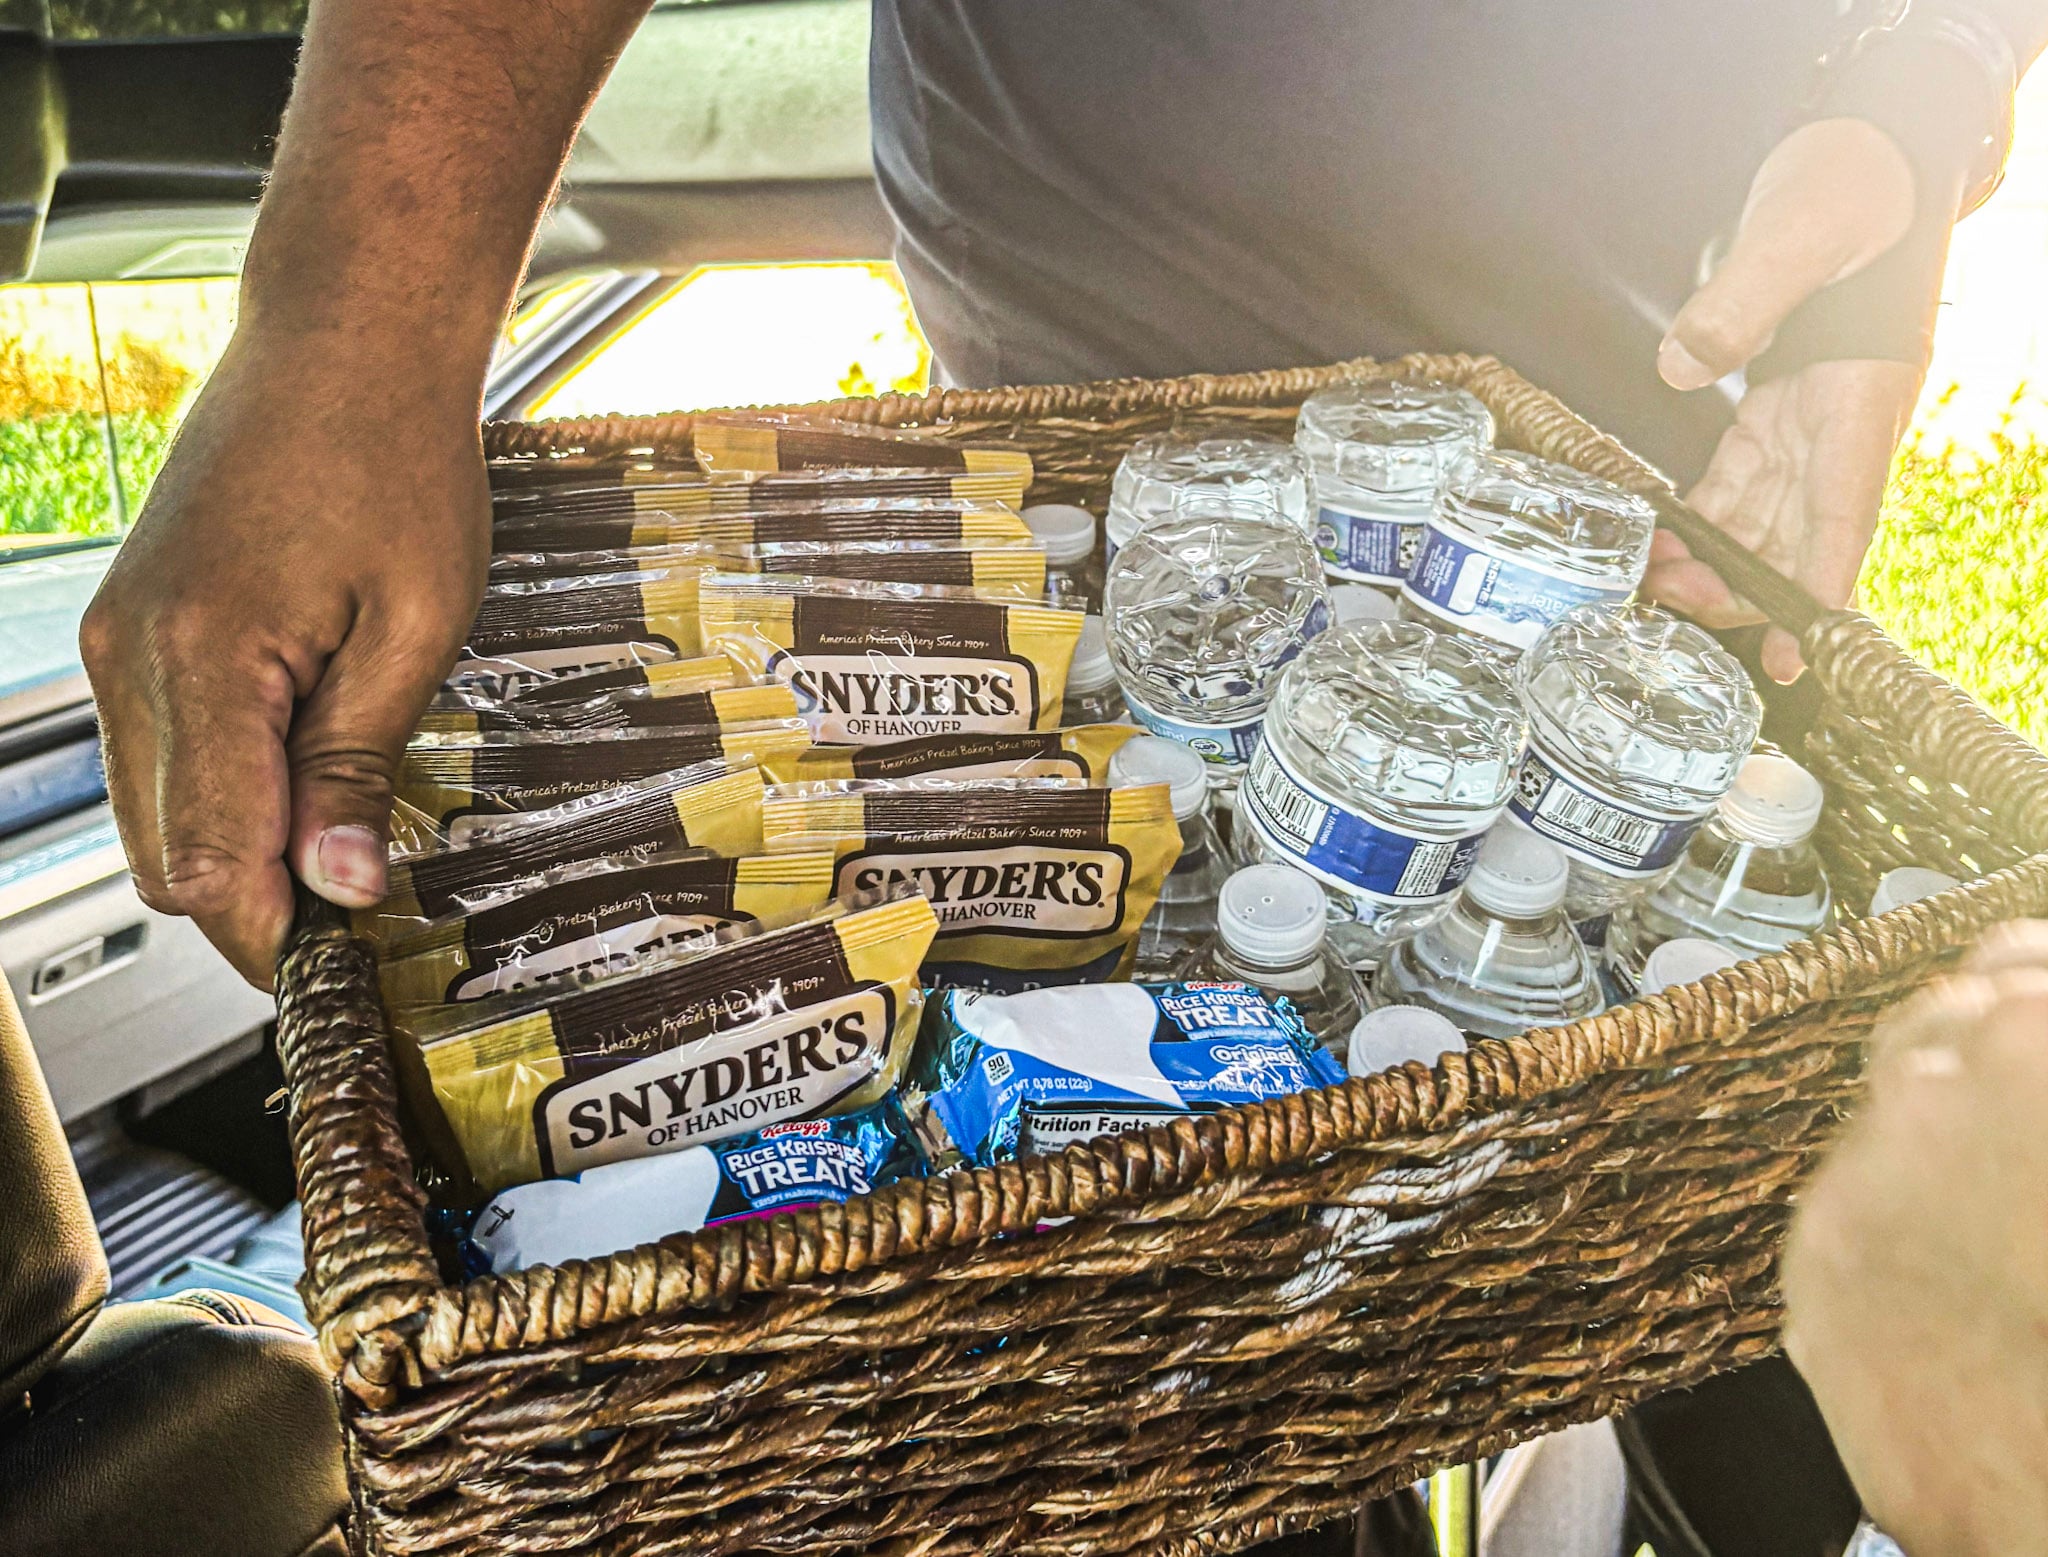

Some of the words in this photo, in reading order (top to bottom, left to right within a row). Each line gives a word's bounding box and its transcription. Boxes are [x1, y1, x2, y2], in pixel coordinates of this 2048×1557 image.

[1477, 558, 1503, 605] NAME:
[819, 633, 863, 645] America's
[936, 637, 961, 648] Since
[964, 640, 985, 649] 1909
[847, 719, 870, 735] OF
[876, 720, 962, 736] HANOVER
[880, 755, 925, 771] America's
[927, 749, 958, 760] Pretzel
[960, 744, 994, 756] Bakery
[995, 739, 1020, 750] Since
[1022, 739, 1042, 748] 1909
[506, 783, 558, 799] America's
[561, 781, 599, 794] Pretzel
[949, 826, 986, 840] Pretzel
[989, 826, 1026, 840] Bakery
[1029, 826, 1056, 838] Since
[1059, 828, 1080, 838] 1909
[557, 909, 596, 929] Pretzel
[598, 897, 643, 918] Bakery
[676, 892, 703, 904] 1909
[941, 902, 1037, 922] HANOVER
[791, 977, 819, 993] 1909
[1162, 994, 1202, 1012] RICE
[1170, 1006, 1274, 1032] TREAT
[988, 1055, 1005, 1072] 90
[568, 1011, 869, 1149] SNYDER'S
[1215, 1080, 1293, 1095] MARSHALLOW
[997, 1087, 1014, 1105] NET
[1015, 1079, 1030, 1092] WT
[1054, 1077, 1067, 1089] OZ
[1067, 1077, 1093, 1093] (22g)
[647, 1124, 681, 1147] OF
[685, 1086, 805, 1134] HANOVER
[1028, 1116, 1090, 1132] trition
[1097, 1116, 1151, 1132] Facts
[761, 1119, 830, 1139] Kellogg's
[726, 1145, 776, 1173] RICE
[776, 1138, 866, 1168] KRISPIES
[735, 1156, 872, 1195] TREATS
